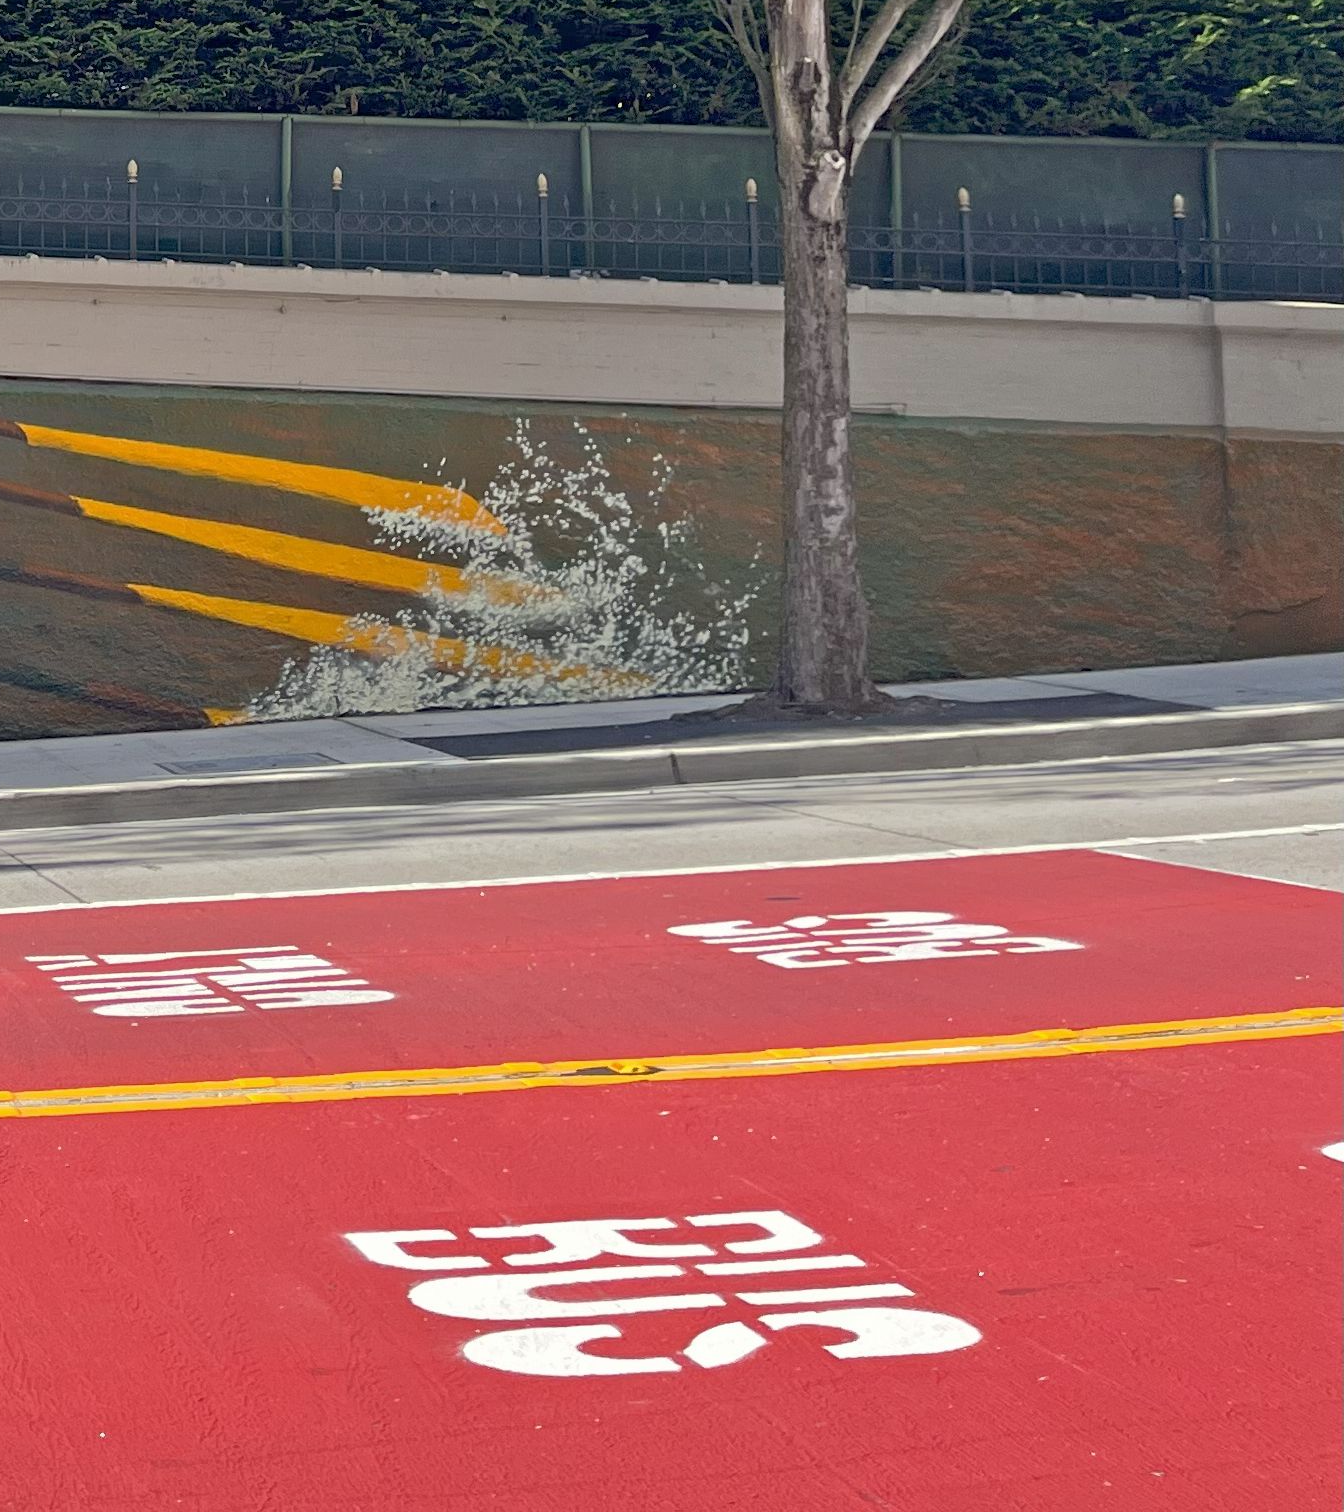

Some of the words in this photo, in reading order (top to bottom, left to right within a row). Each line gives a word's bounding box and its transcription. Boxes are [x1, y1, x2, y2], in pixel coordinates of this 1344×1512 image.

[668, 912, 1083, 968] BUS
[27, 946, 394, 1016] ONLY
[344, 1211, 982, 1376] BUS
